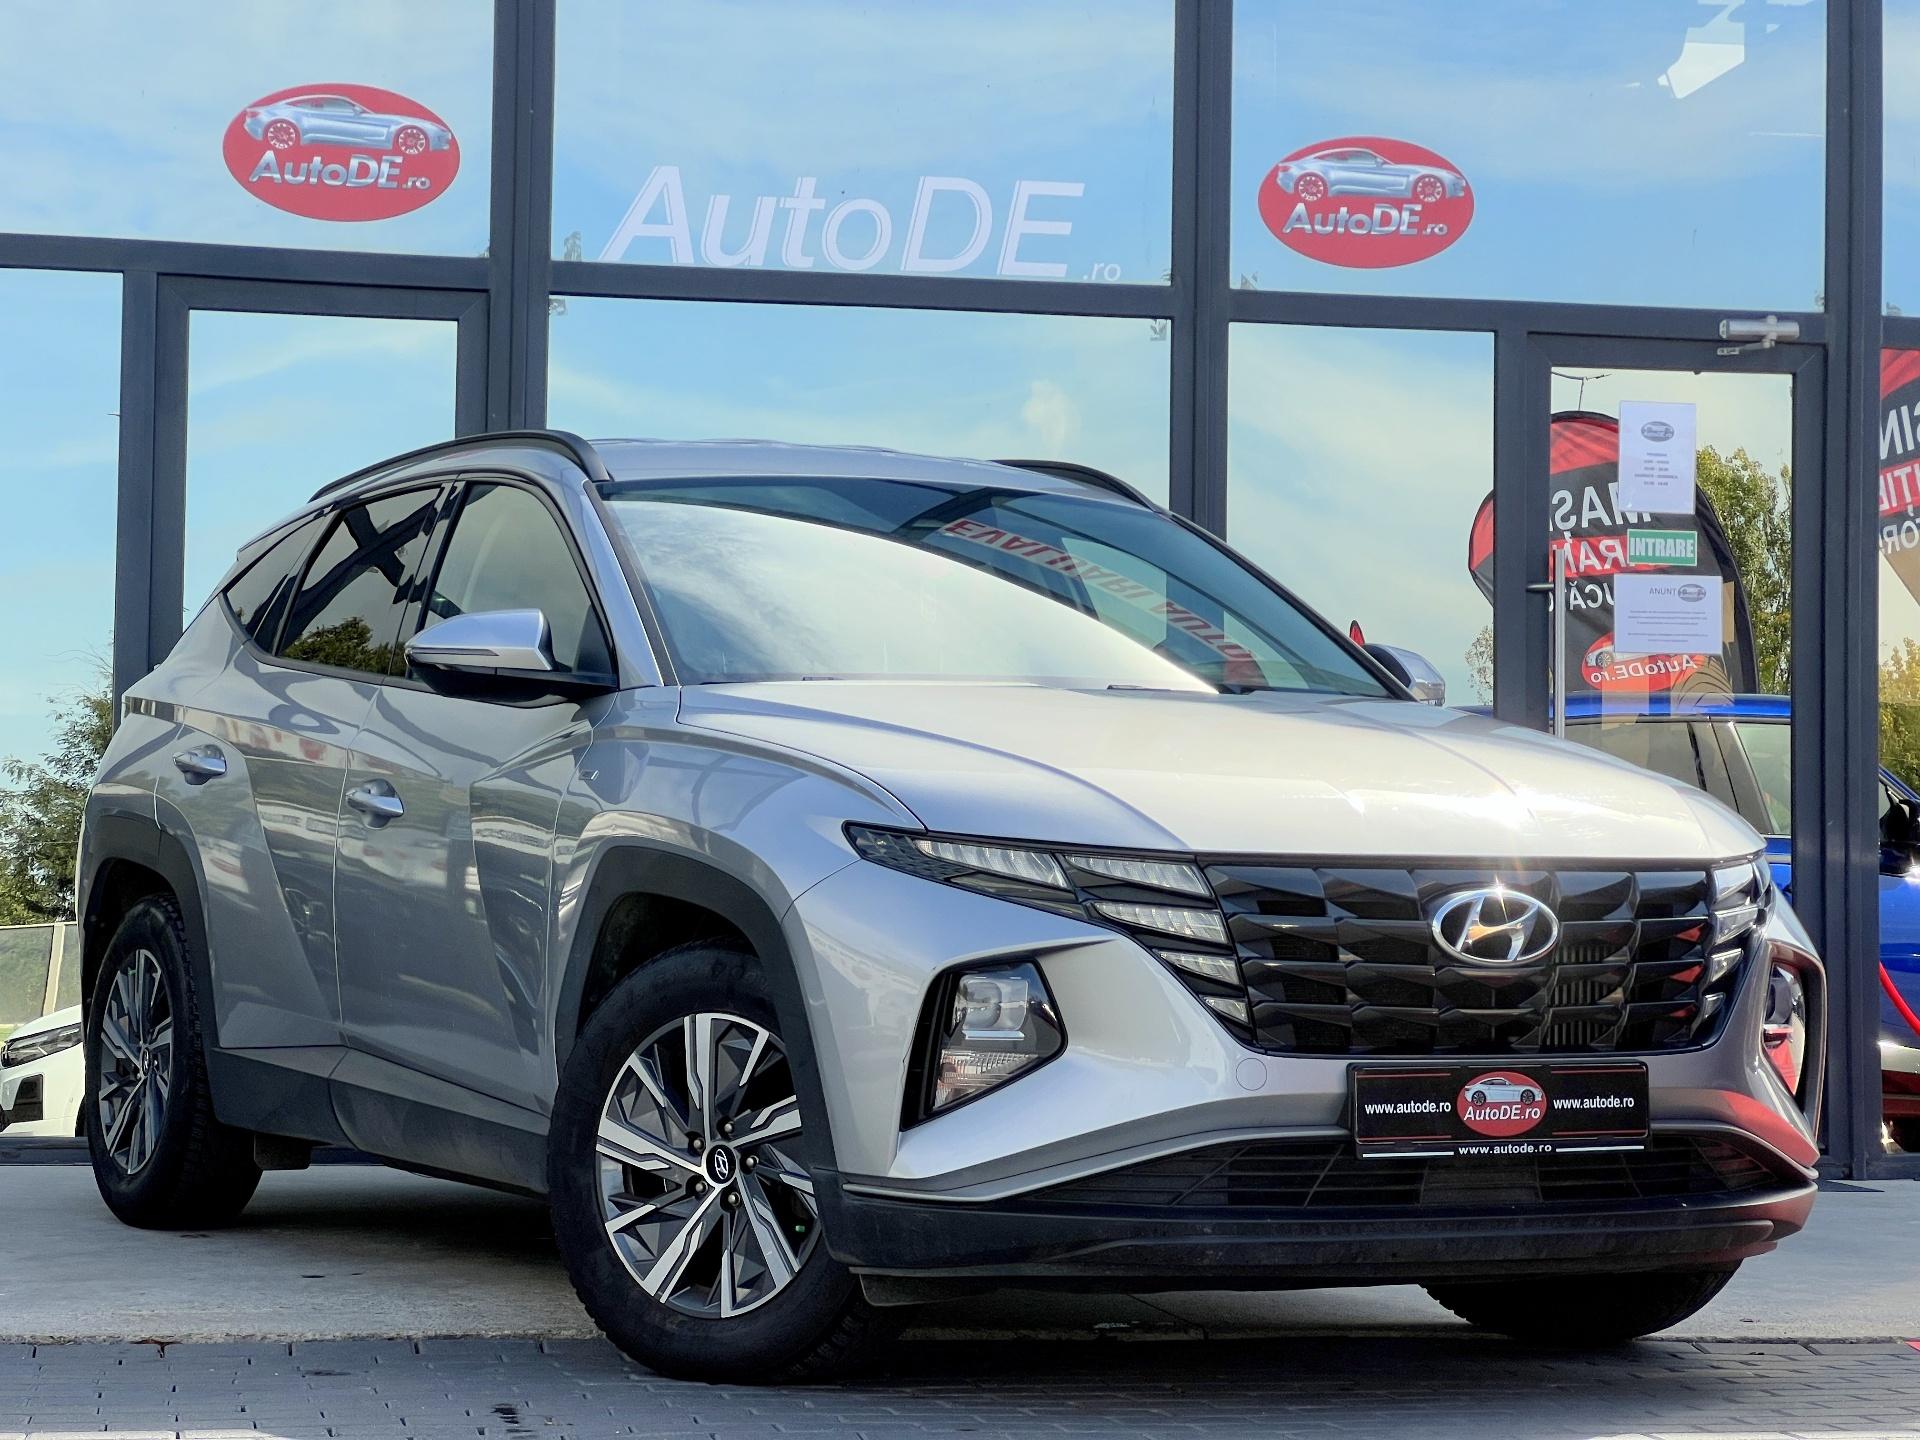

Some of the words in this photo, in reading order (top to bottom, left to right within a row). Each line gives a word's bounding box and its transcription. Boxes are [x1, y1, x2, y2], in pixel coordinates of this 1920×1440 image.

[1630, 537, 1694, 558] INTRARE
[1365, 1100, 1451, 1115] www.autode.ro
[1553, 1095, 1635, 1110] www.autode.ro
[1464, 1104, 1541, 1121] AutoDE.ro
[1458, 1143, 1552, 1155] www.autode.ro
